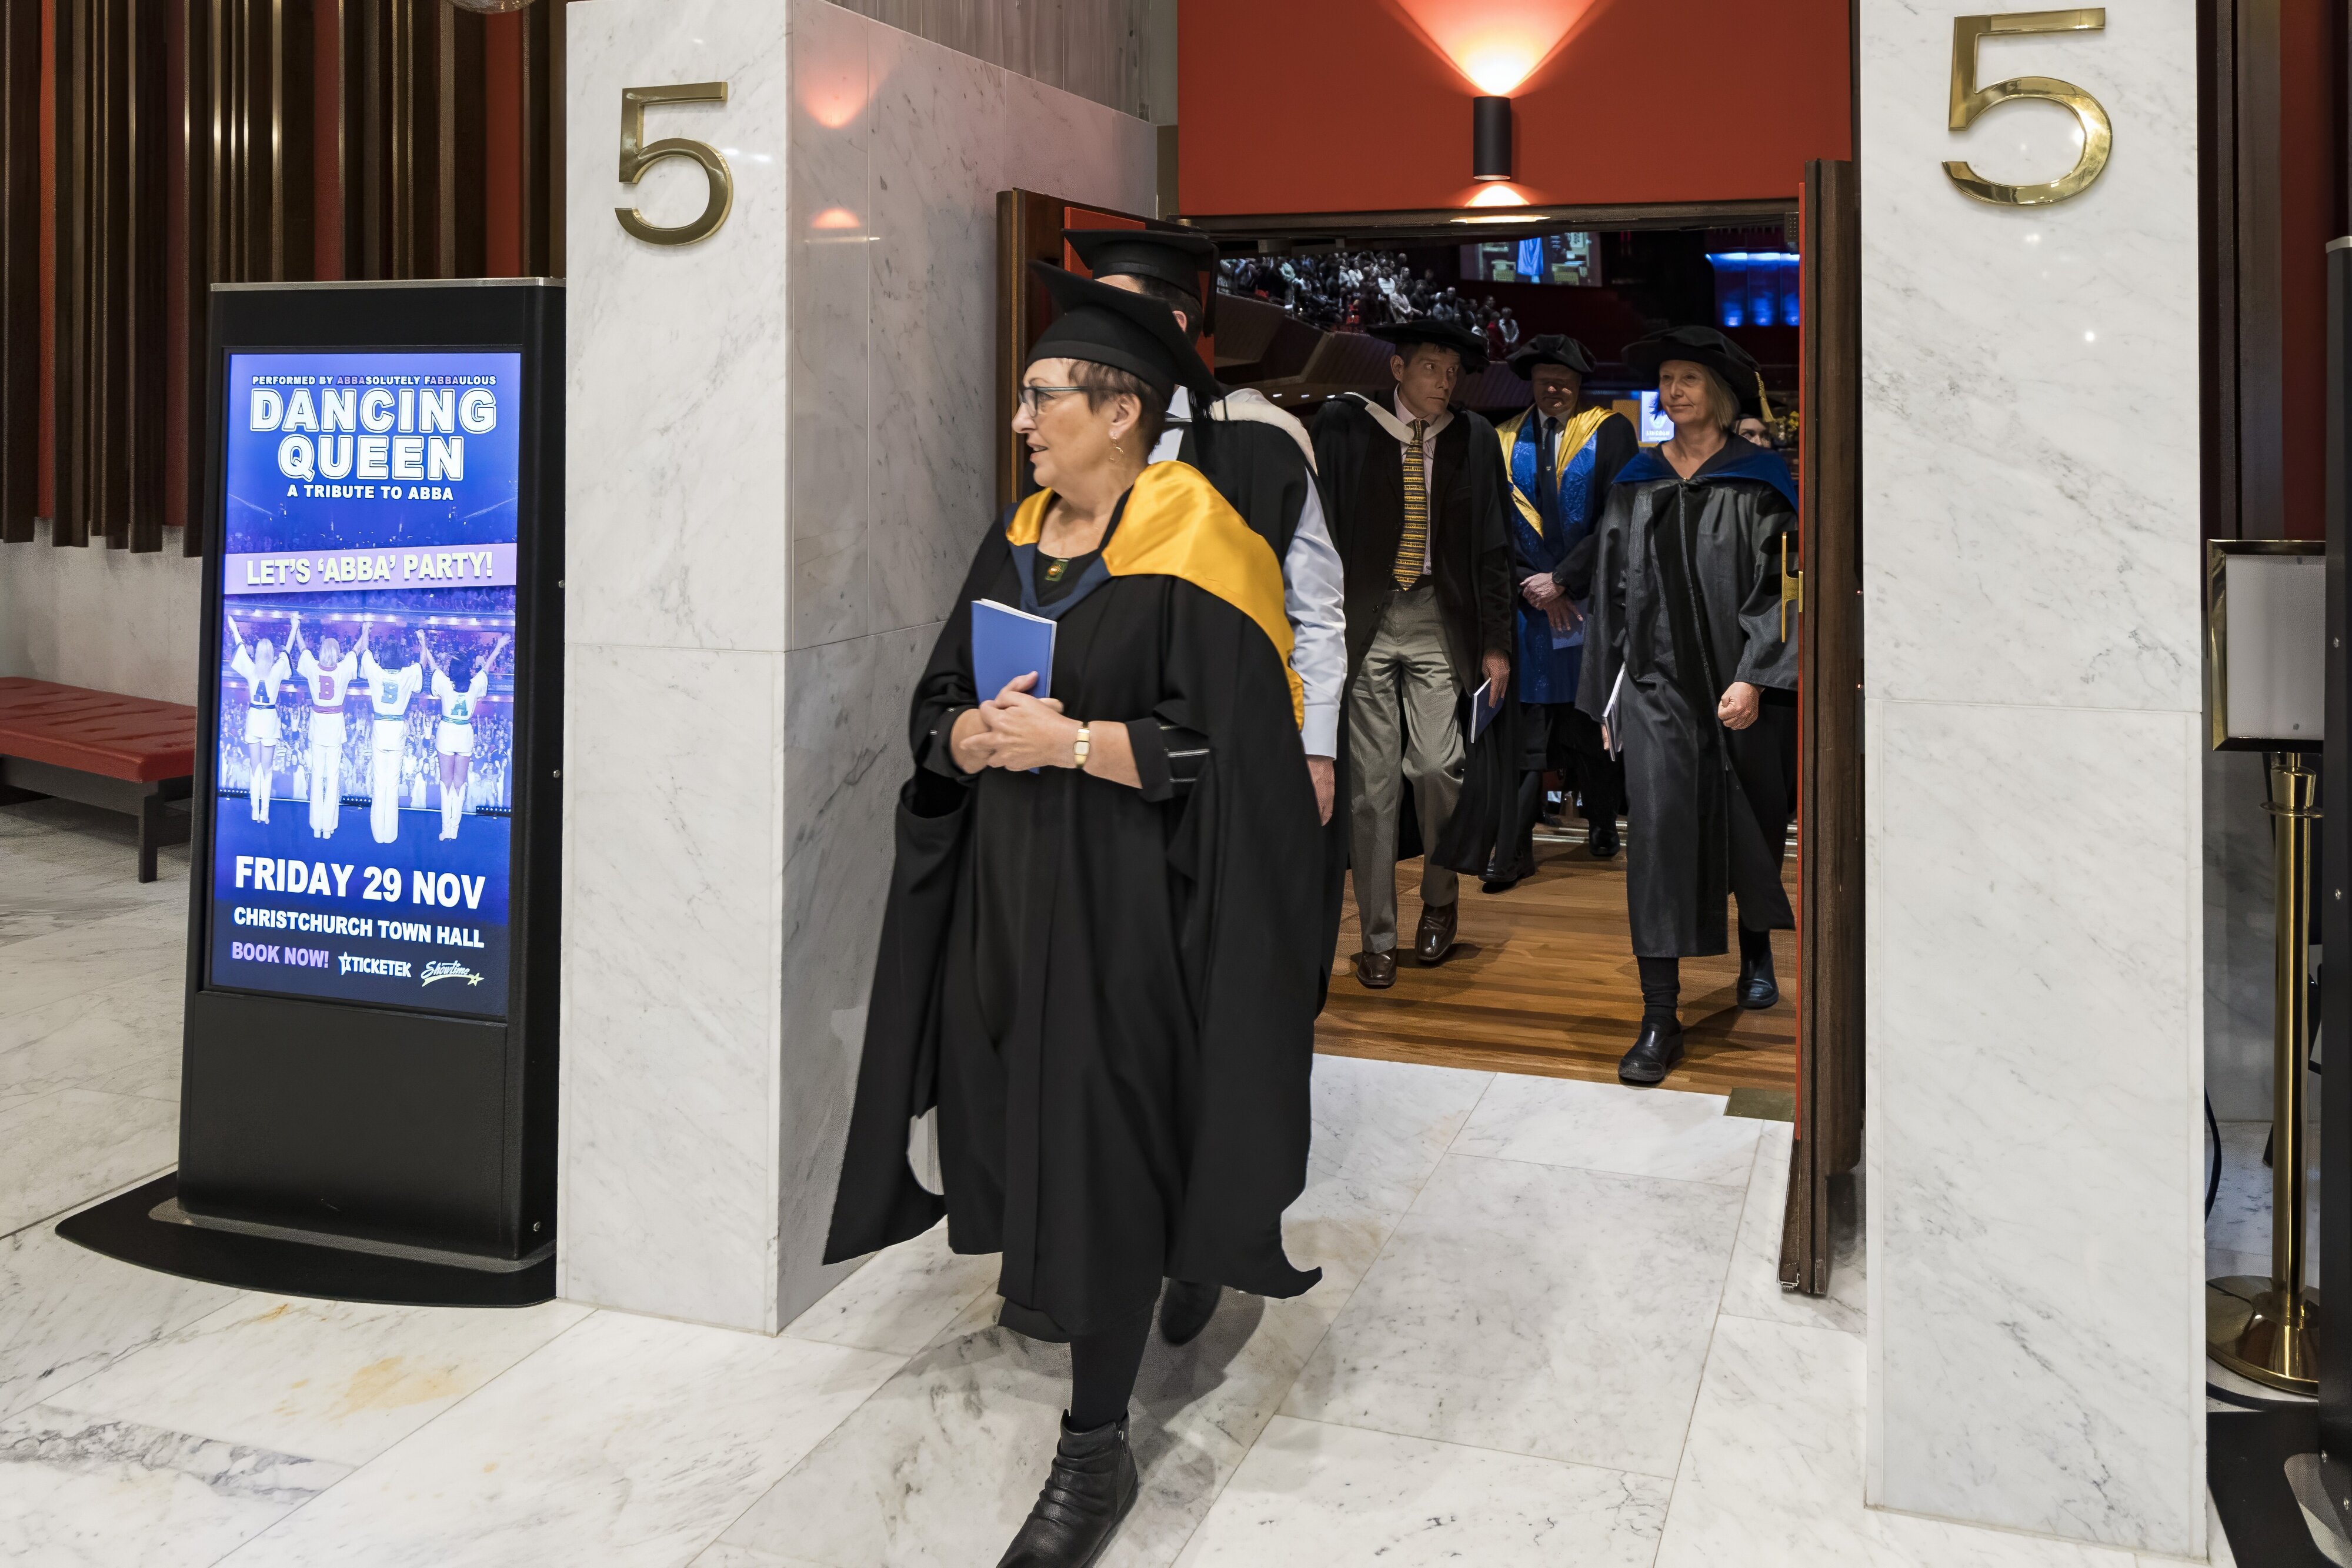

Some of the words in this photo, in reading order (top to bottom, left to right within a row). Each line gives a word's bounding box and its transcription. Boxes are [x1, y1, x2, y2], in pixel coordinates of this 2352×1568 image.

[1941, 8, 2113, 206] 5
[615, 81, 733, 246] 5
[252, 376, 316, 385] PERFORMED
[319, 376, 334, 385] BY
[337, 376, 421, 386] ABBASOLUTELY
[424, 376, 497, 386] FABBAULOUS
[250, 388, 496, 434] DANCING
[278, 434, 465, 482] QUEEN
[287, 485, 298, 497] A
[303, 485, 375, 499] TRIBUTE
[381, 486, 403, 499] TO
[408, 486, 453, 501] ABBA
[403, 552, 493, 579] PARTY!
[319, 675, 334, 700] B
[235, 855, 354, 897] FRIDAY
[362, 866, 402, 902] 29
[413, 870, 486, 909] NOV
[233, 907, 373, 937] CHRISTCHURCH
[378, 920, 432, 942] TOWN
[436, 928, 485, 948] HALL
[232, 942, 279, 963] BOOK
[284, 948, 329, 968] NOW!
[352, 956, 412, 978] TICKETEK
[421, 960, 471, 979] Showtime
